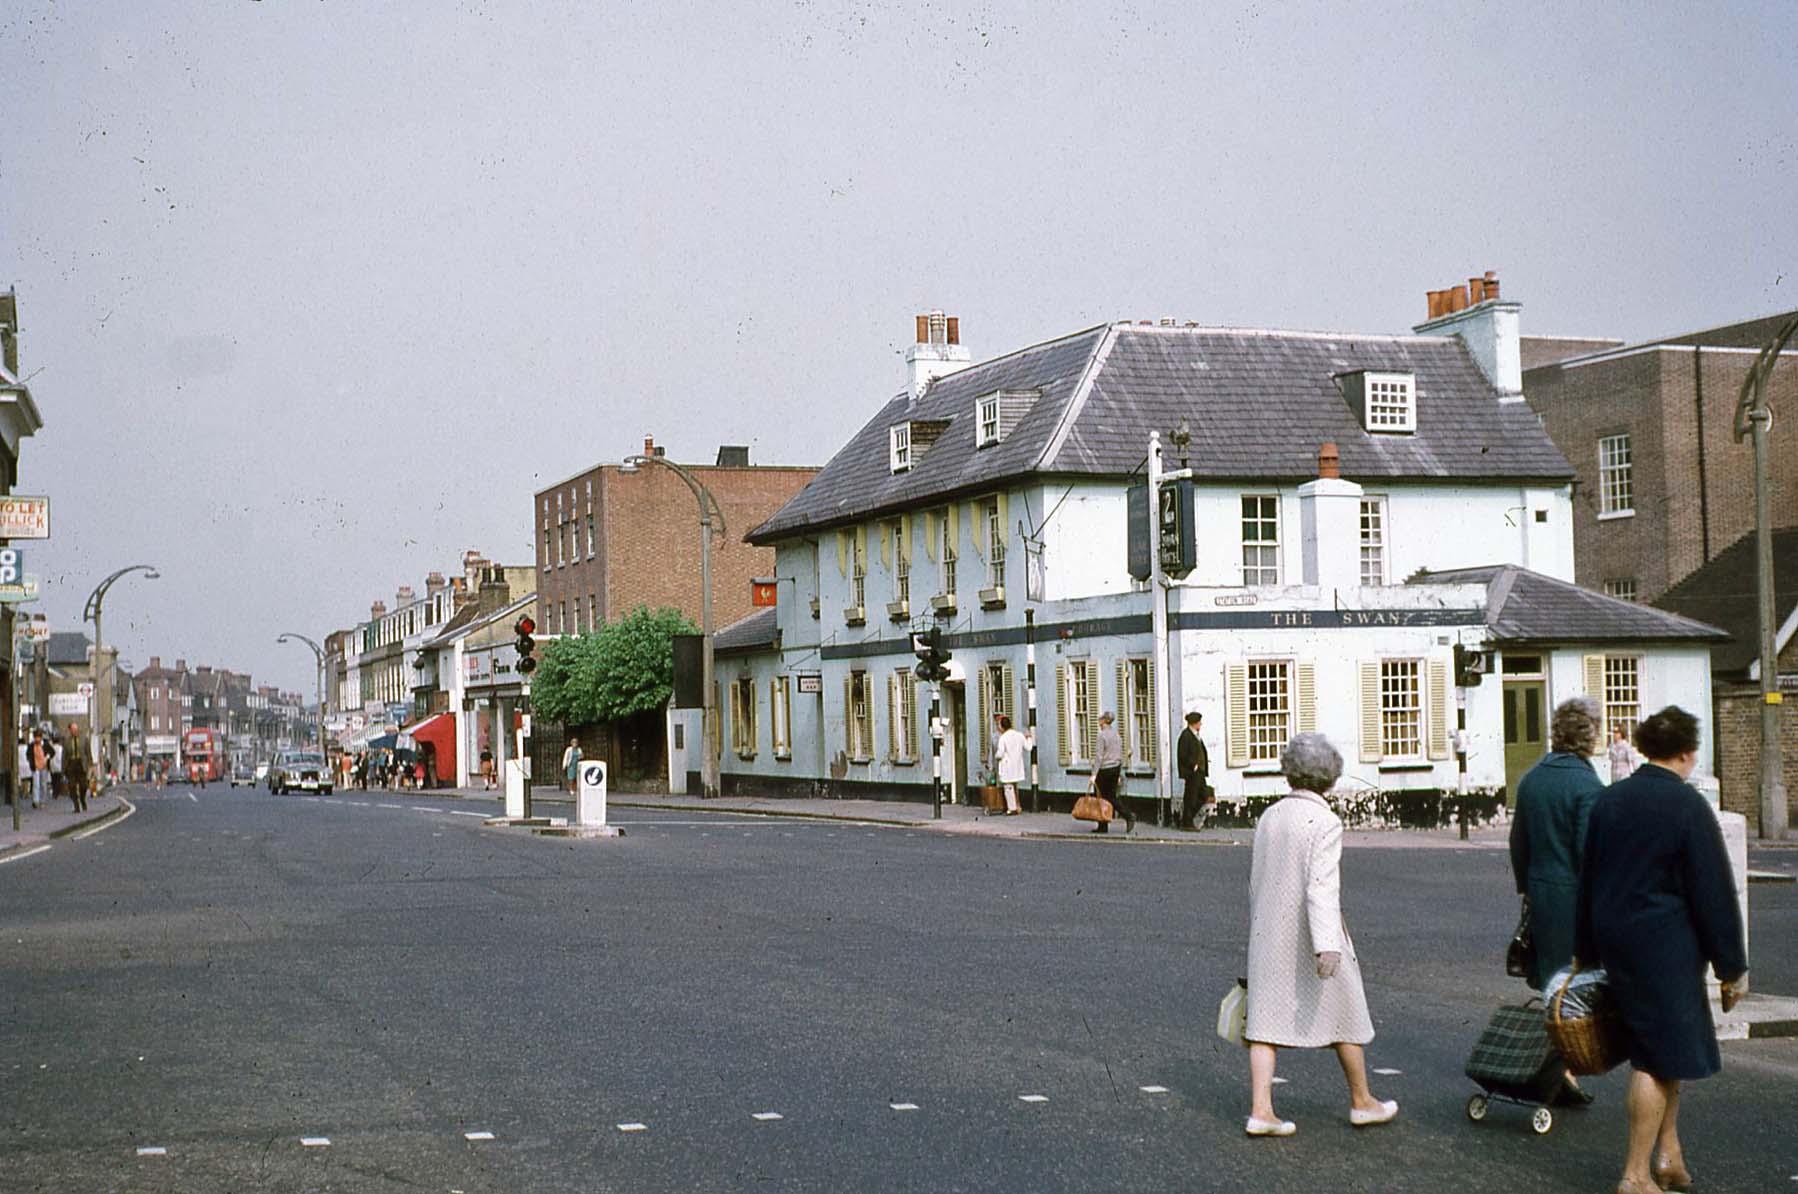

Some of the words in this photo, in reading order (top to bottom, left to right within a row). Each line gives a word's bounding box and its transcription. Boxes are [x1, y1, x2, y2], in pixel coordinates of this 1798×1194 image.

[18, 501, 45, 513] LET
[1271, 612, 1312, 625] THE
[1343, 611, 1401, 625] SWAN
